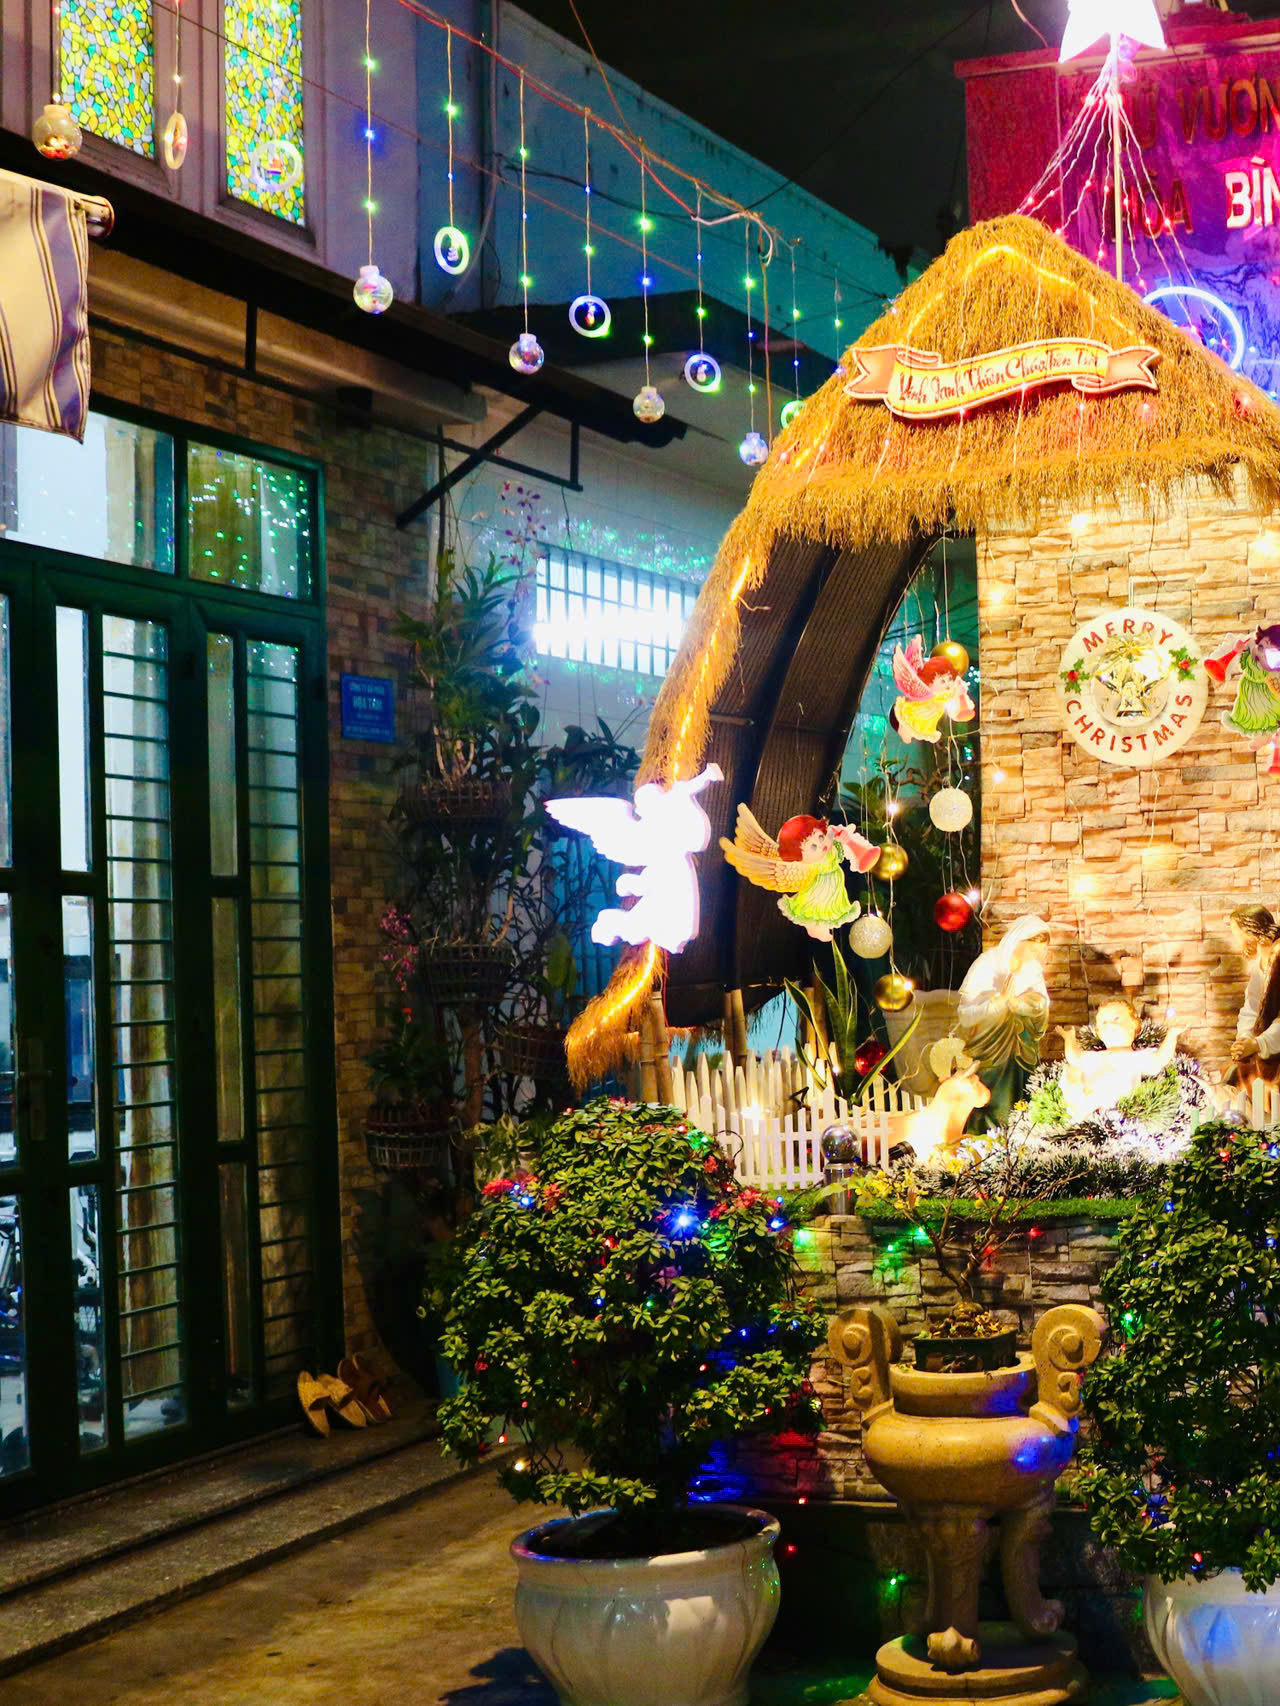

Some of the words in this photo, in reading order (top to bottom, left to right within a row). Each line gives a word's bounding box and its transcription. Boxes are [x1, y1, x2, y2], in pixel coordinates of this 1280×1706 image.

[1005, 351, 1047, 378] Chúa
[1082, 618, 1173, 653] MERRY
[1066, 694, 1193, 753] CHRISTMAS
